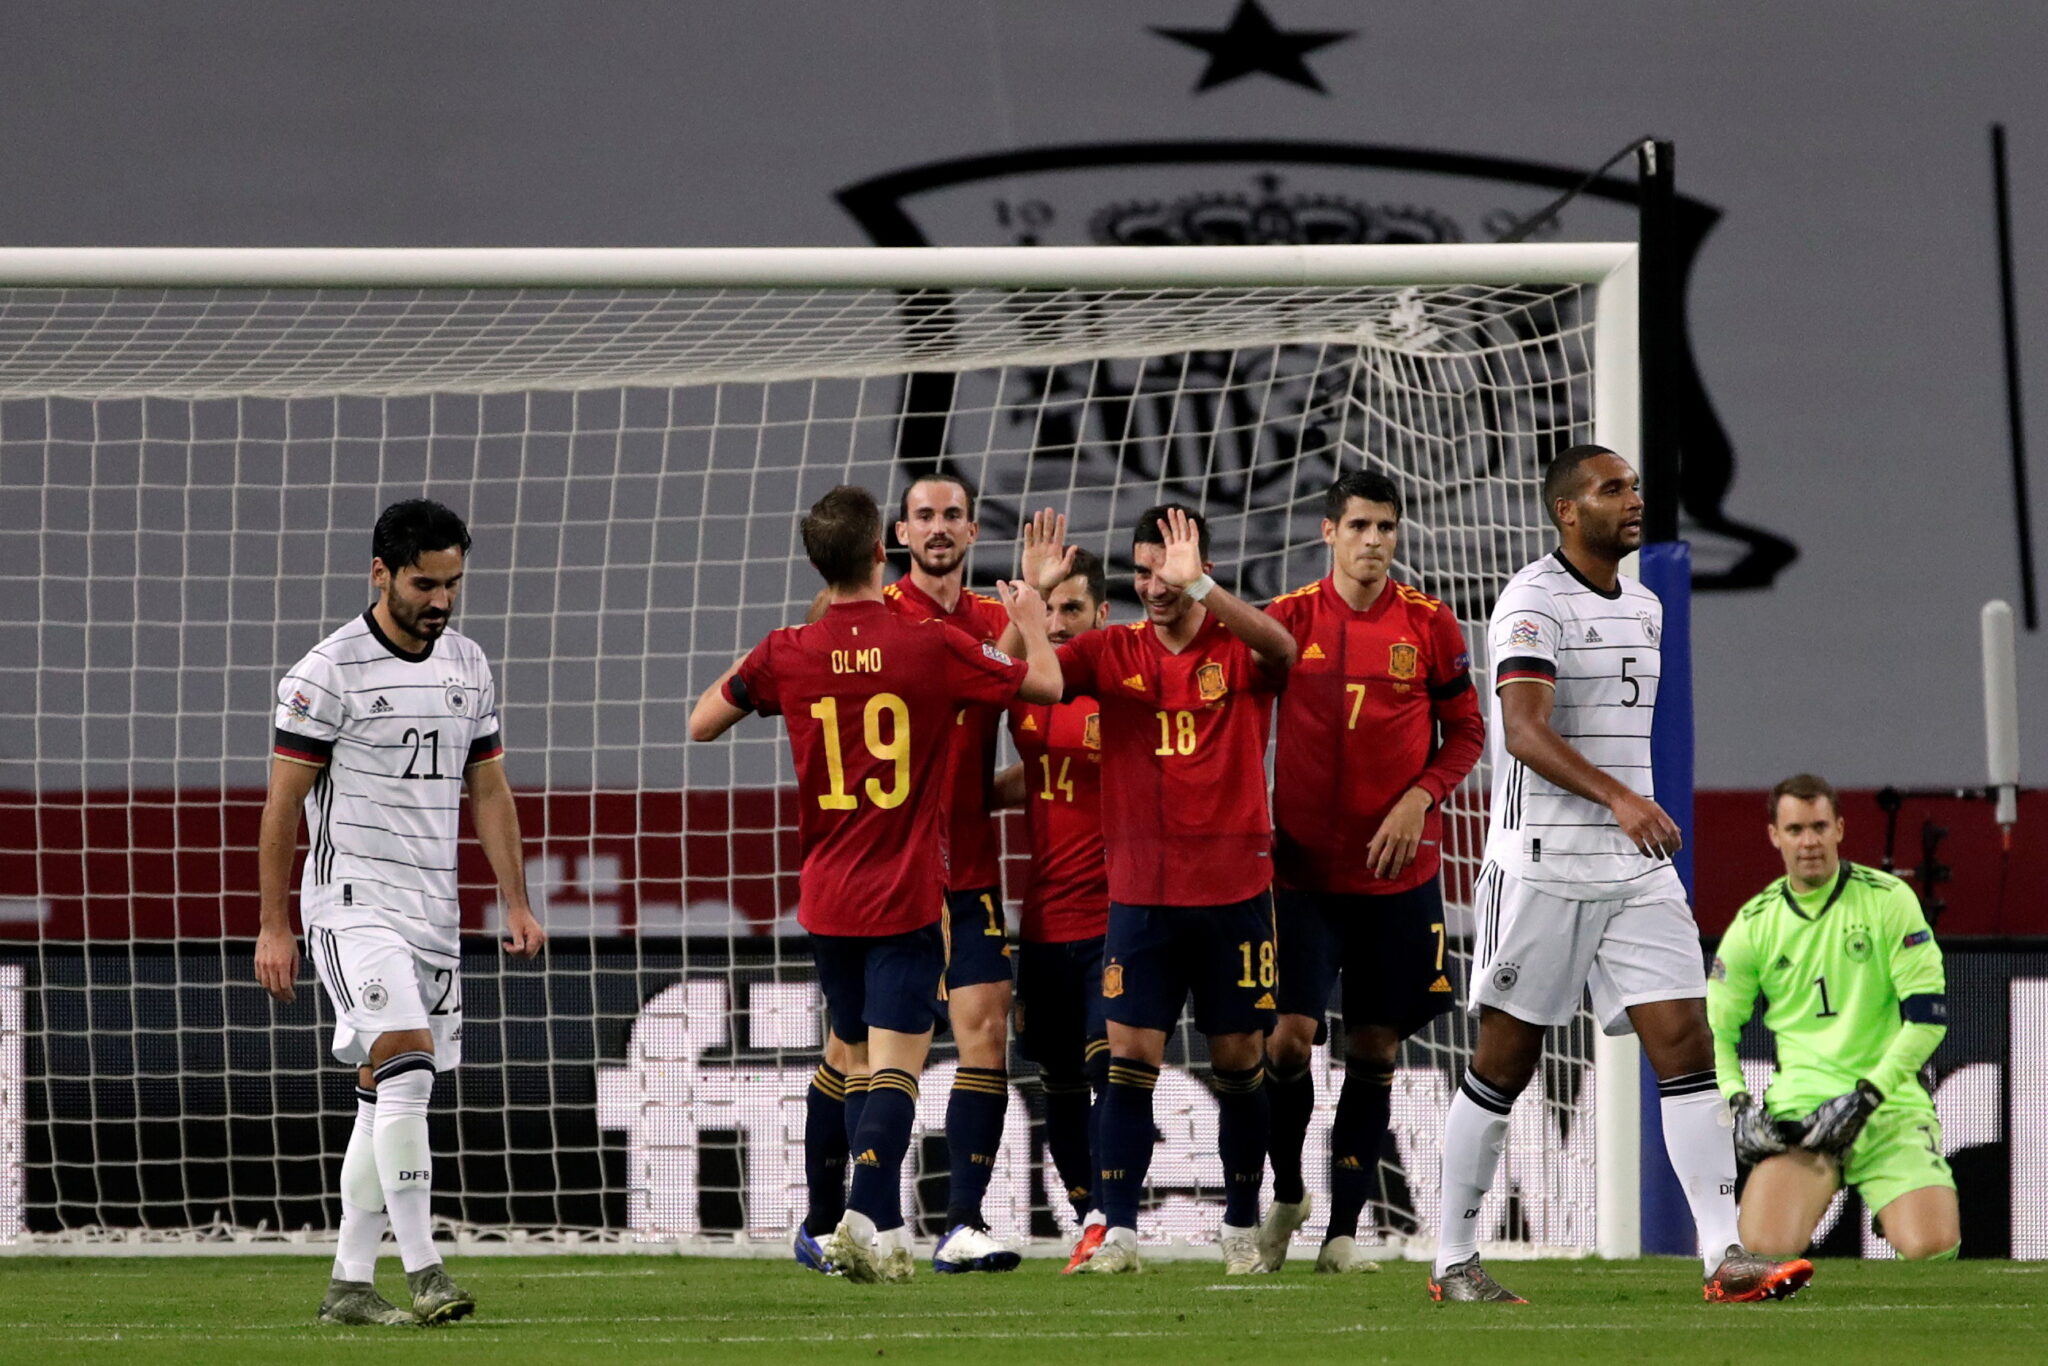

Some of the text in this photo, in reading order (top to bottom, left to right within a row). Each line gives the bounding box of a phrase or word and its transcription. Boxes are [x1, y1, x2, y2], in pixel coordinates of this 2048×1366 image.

[832, 648, 882, 674] OLMO
[1621, 657, 1640, 708] 5
[1346, 683, 1366, 730] 7
[401, 727, 444, 780] 21
[811, 692, 910, 810] 19
[1155, 710, 1196, 755] 18
[1040, 754, 1074, 802] 14
[1237, 940, 1275, 988] 18
[1430, 923, 1444, 970] 7
[1812, 976, 1838, 1018] 1
[400, 1170, 430, 1180] DFB
